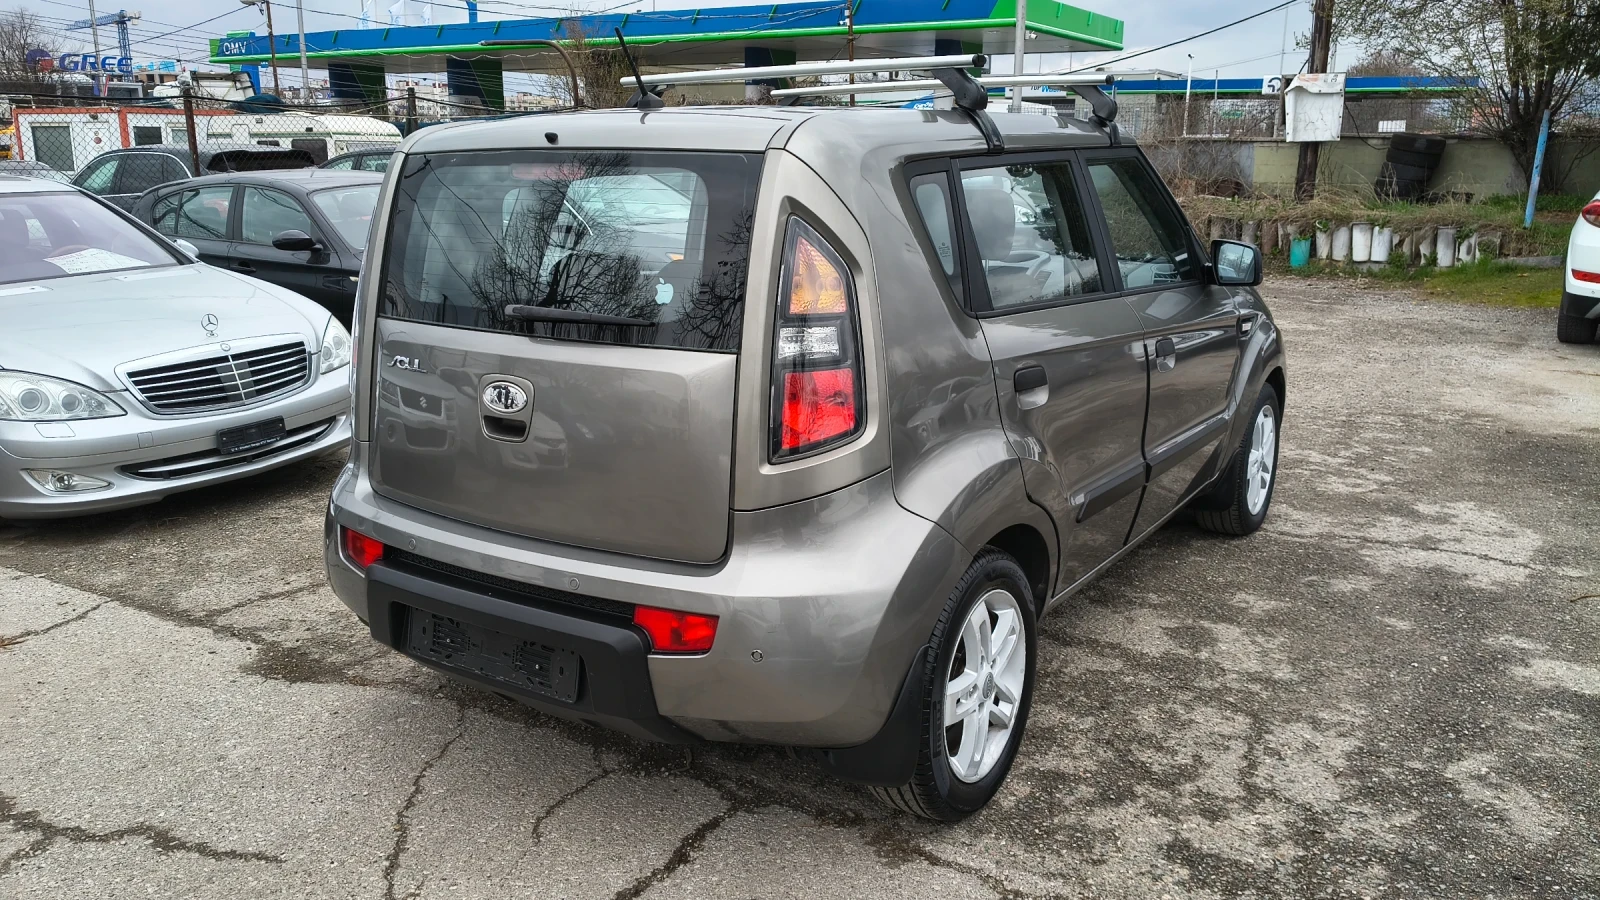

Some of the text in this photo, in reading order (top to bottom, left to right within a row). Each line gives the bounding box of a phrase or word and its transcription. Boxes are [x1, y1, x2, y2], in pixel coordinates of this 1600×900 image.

[223, 41, 247, 55] OMV
[58, 53, 134, 73] GREE
[386, 355, 429, 374] SOUL
[489, 385, 521, 407] KIA
